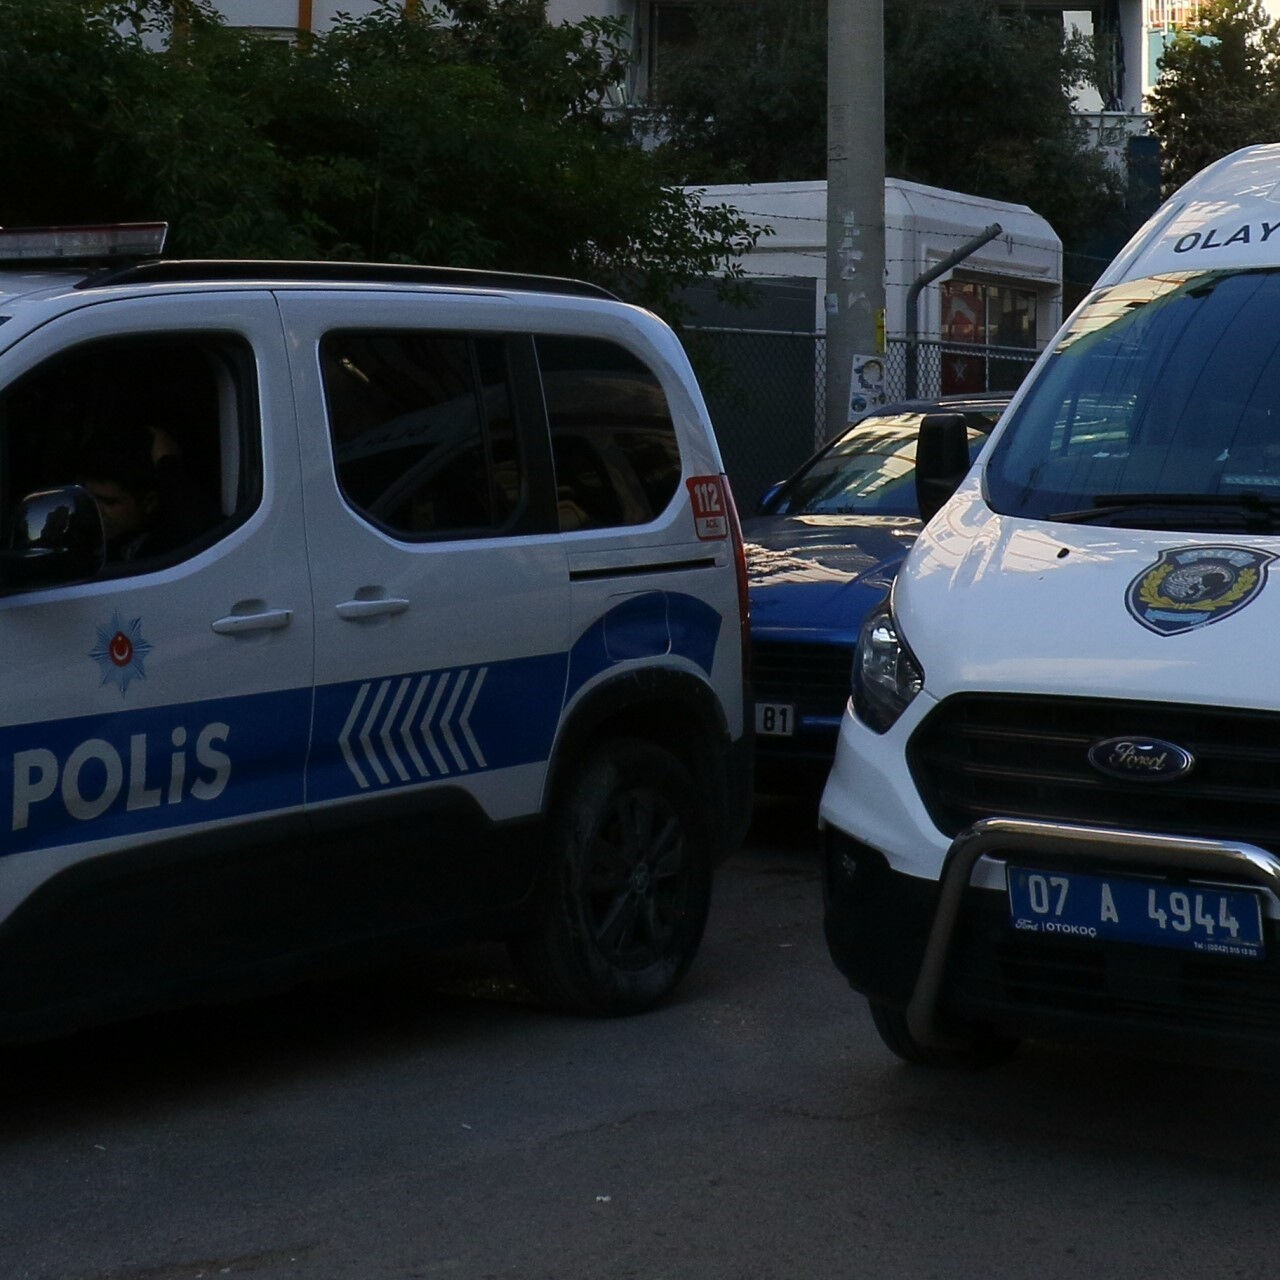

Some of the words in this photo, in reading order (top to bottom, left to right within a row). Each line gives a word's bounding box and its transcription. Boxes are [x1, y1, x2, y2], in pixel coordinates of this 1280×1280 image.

[694, 483, 720, 513] 112
[1107, 742, 1168, 771] Ford
[1028, 874, 1070, 916] 07
[1100, 883, 1119, 924] A
[1148, 888, 1239, 938] 4944
[1046, 921, 1097, 939] OTOKOÇ
